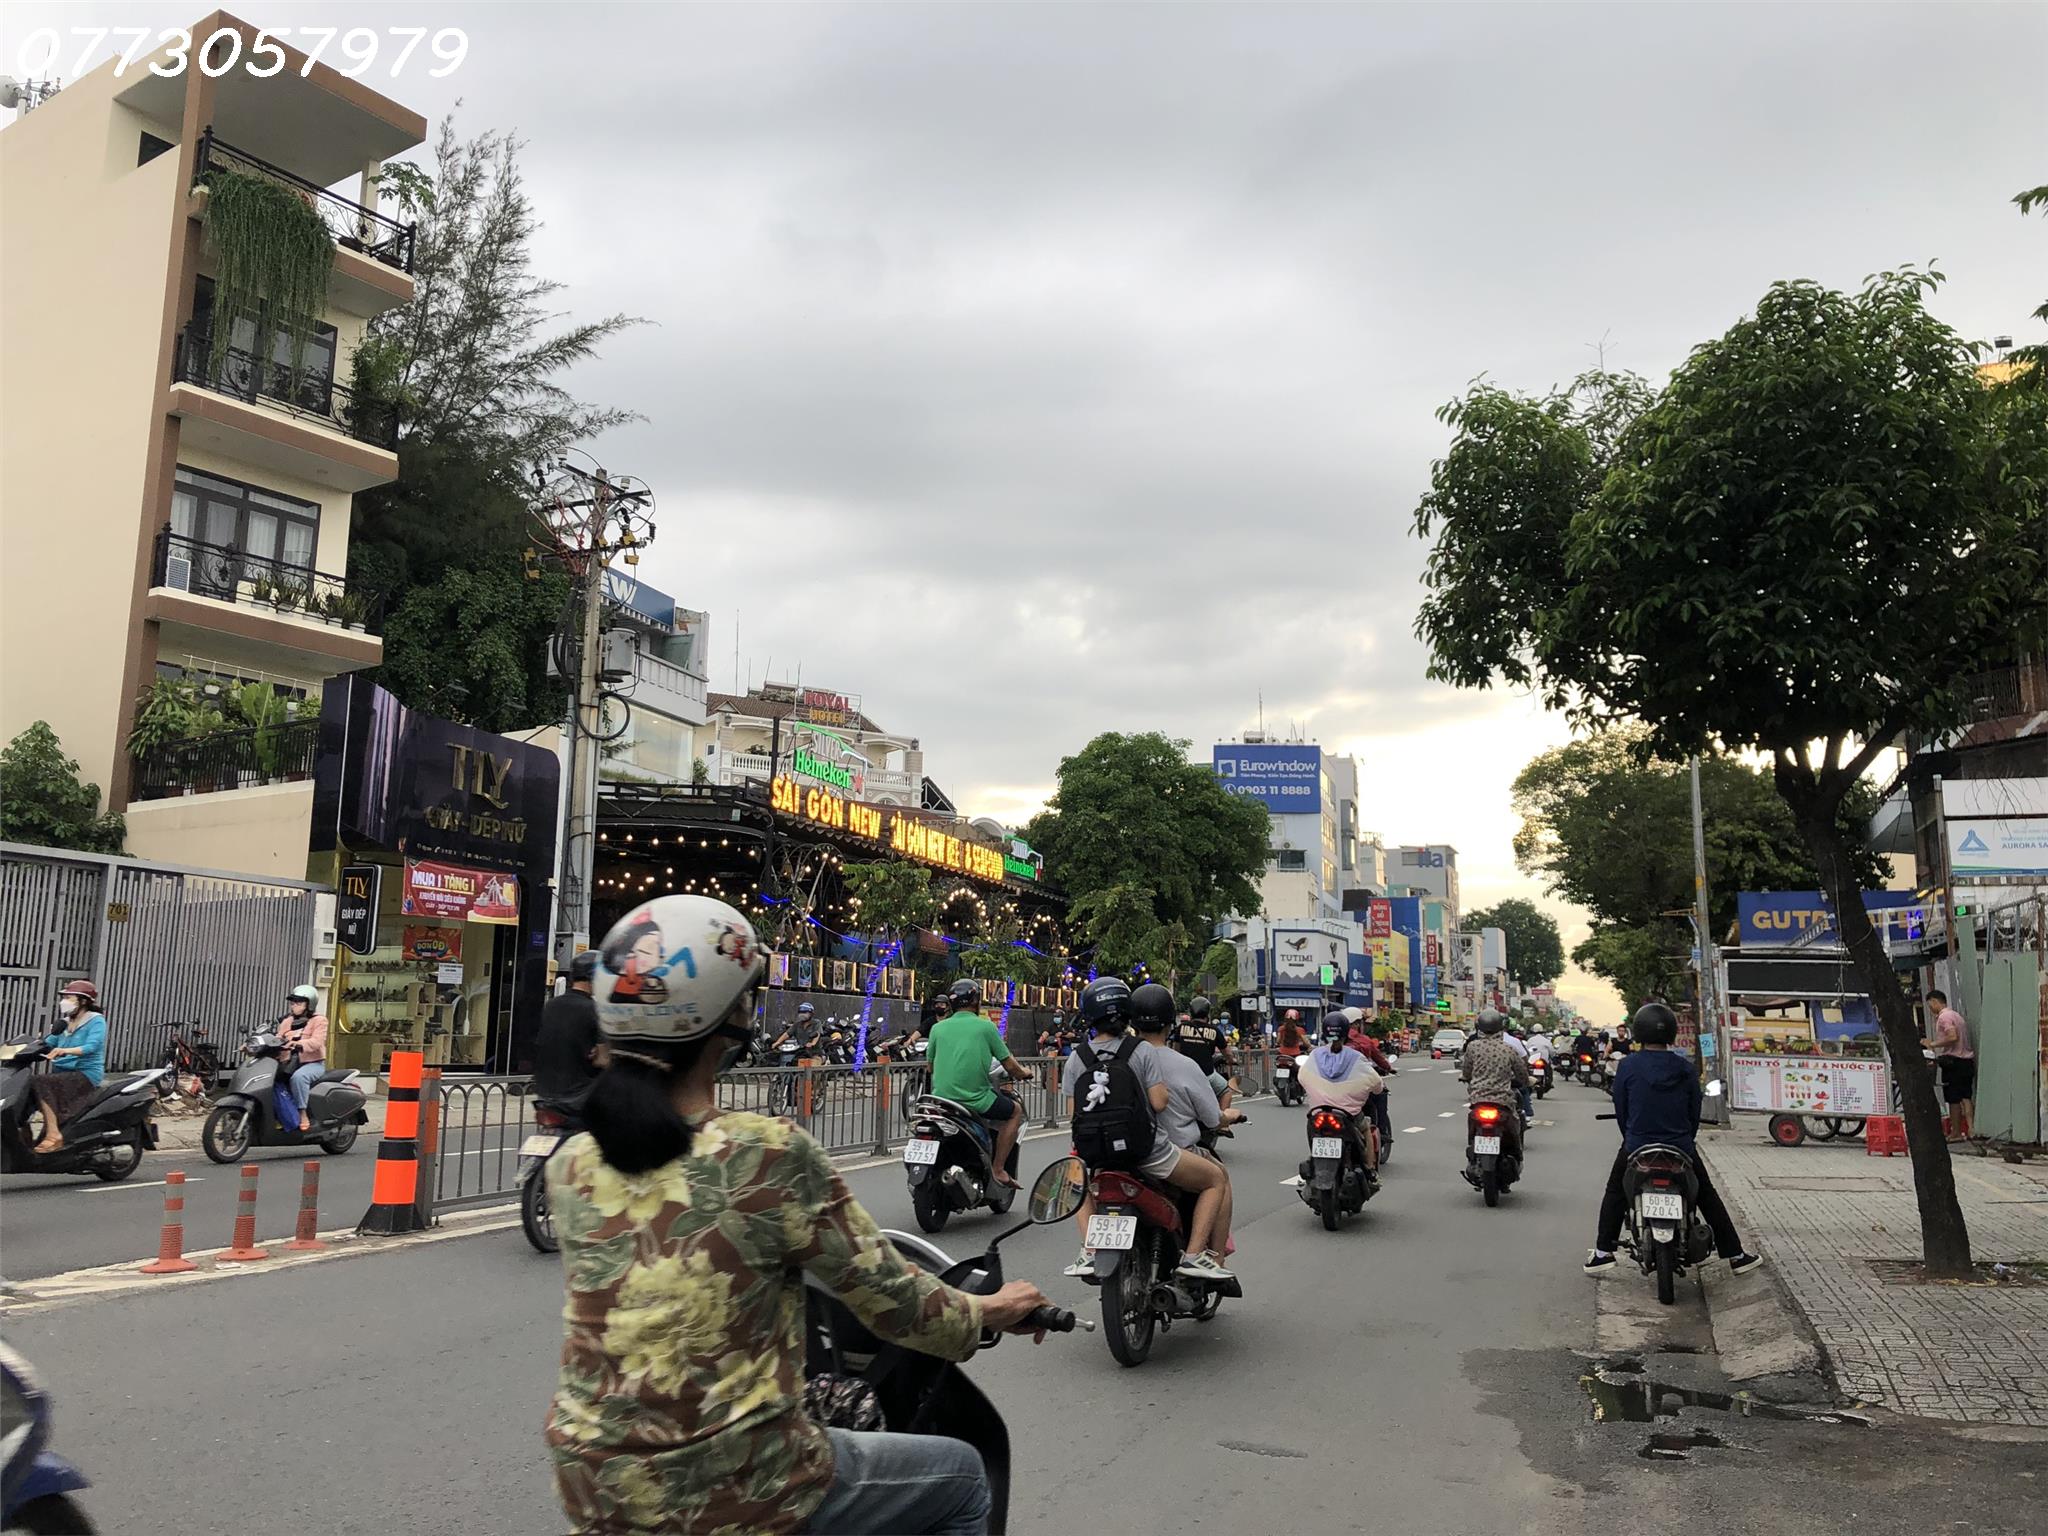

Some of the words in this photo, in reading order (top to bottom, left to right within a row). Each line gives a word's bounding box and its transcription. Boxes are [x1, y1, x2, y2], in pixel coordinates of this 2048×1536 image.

[804, 691, 852, 712] ROYAL
[809, 709, 846, 723] HOTEL
[812, 733, 841, 760] SILVER
[795, 748, 851, 788] Heineken
[1240, 759, 1317, 772] Eurowindow
[446, 742, 513, 809] TLY
[1238, 785, 1267, 795] 0903
[1269, 785, 1278, 795] 11
[1281, 785, 1311, 795] 8888
[771, 773, 800, 814] SÀI
[807, 785, 844, 828] GÒN
[849, 802, 881, 839] NEW
[927, 828, 946, 863] NEW
[345, 876, 370, 898] TLY
[411, 870, 435, 887] MUA
[1280, 954, 1313, 962] TUTIMI
[1735, 1059, 1761, 1067] SINH
[1765, 1058, 1780, 1068] TỐ
[1831, 1062, 1865, 1070] NƯỚC
[1868, 1062, 1884, 1071] ÉP
[1095, 1218, 1129, 1232] 59-V2
[1086, 1232, 1132, 1247] 276.07
